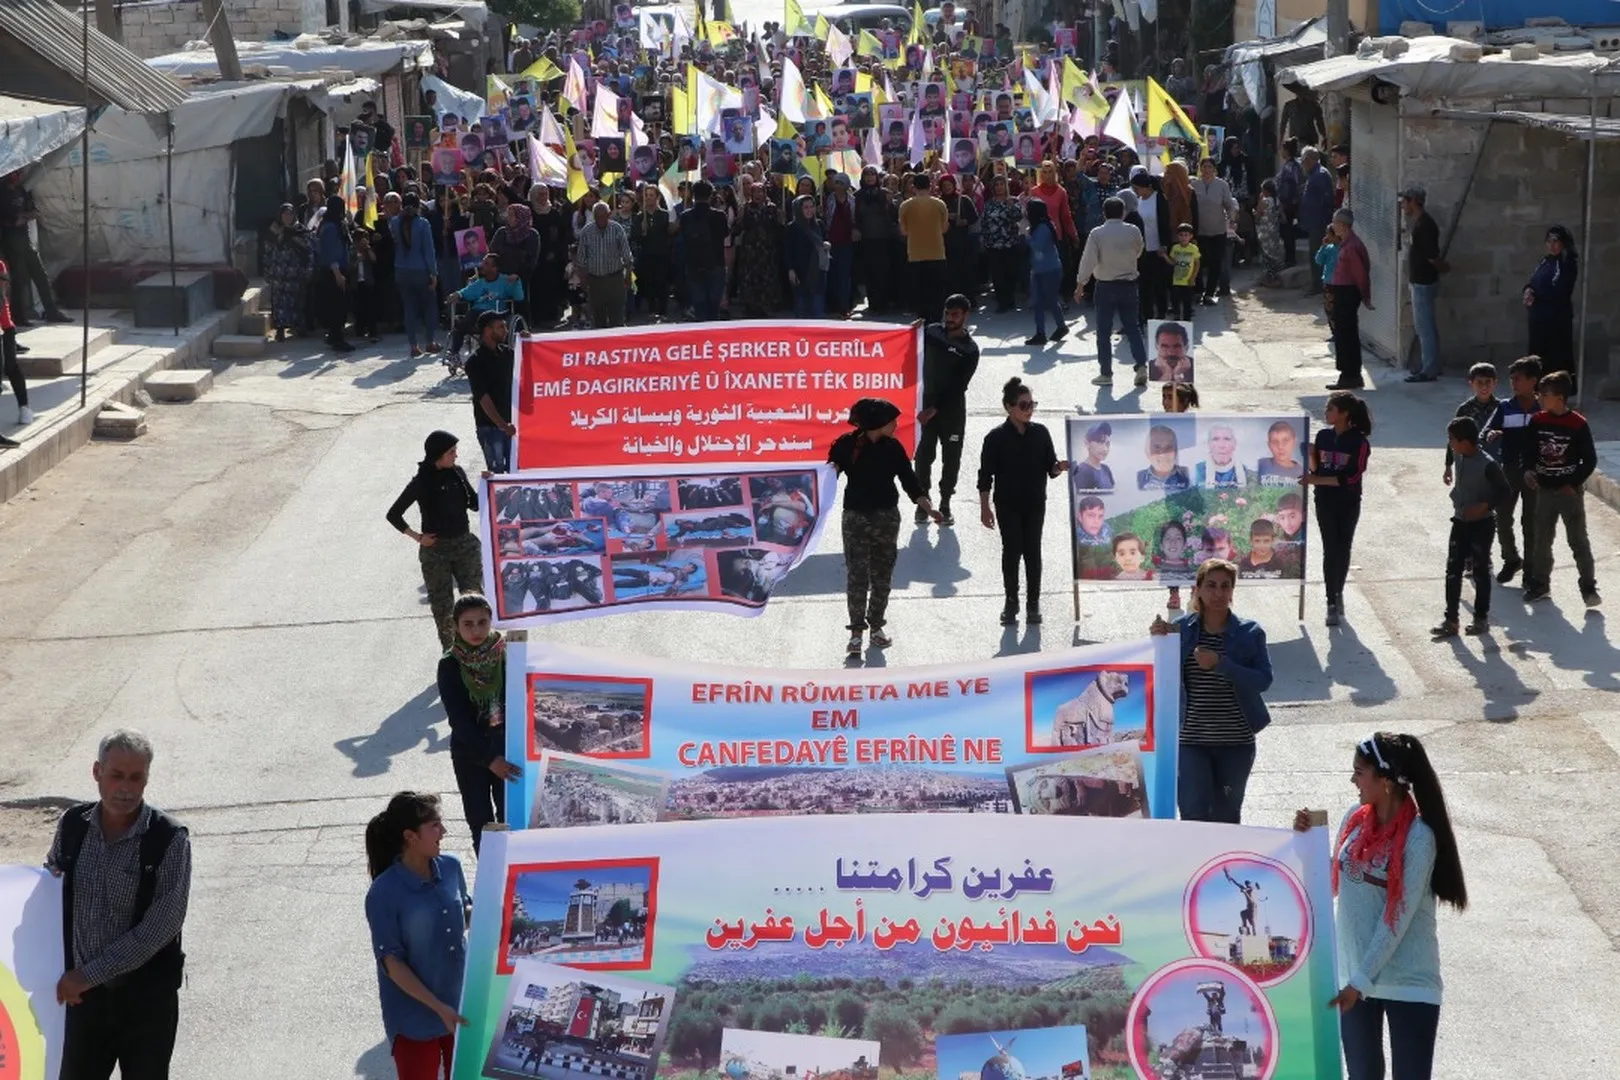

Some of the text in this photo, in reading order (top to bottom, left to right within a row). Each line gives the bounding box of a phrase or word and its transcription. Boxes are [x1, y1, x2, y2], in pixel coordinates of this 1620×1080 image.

[562, 338, 885, 367] BI RASTIYA GELÊ ŞERKER Û GERÎLA
[533, 370, 904, 398] EMÊ DAGIRKERIYÊ Û ÎXANETÊ TÊK BIBIN
[570, 403, 851, 430] حرب الشعبية الثورية وببسالة الكريلا
[622, 433, 813, 457] سندحر الإحتلال والخيانة
[691, 677, 990, 704] EFRÎN RÛMETA ME YE
[811, 708, 860, 730] EM
[678, 734, 1004, 767] CANFEDAYÊ EFRÎNÊ NE
[835, 856, 953, 898] كرامتنا
[962, 858, 1055, 900] عفرين
[705, 897, 1123, 954] نحن فدائيون من أجل عفرين
